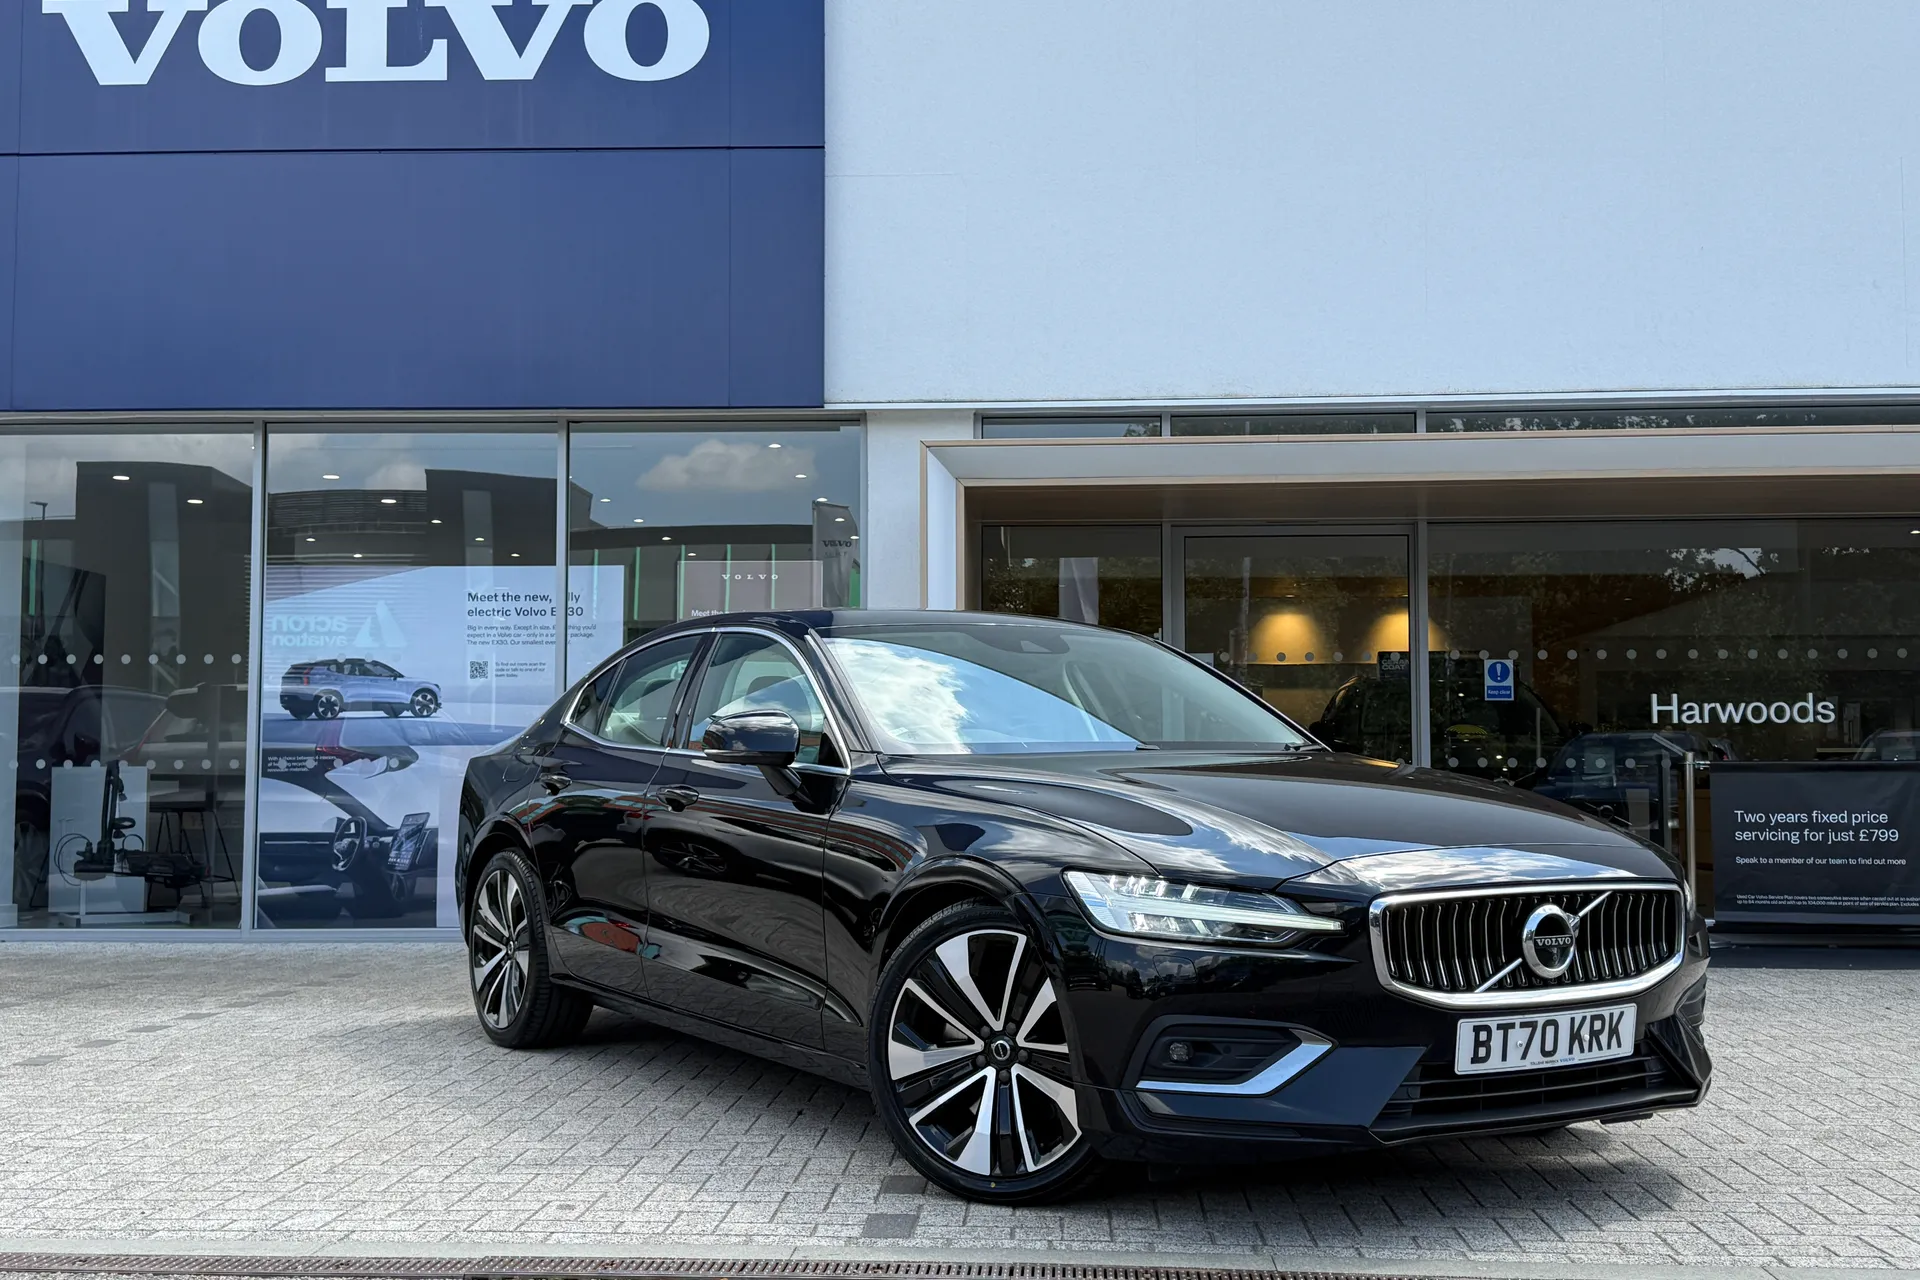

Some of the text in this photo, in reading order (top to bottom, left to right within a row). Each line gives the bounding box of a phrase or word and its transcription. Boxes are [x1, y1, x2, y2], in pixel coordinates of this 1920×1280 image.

[41, 0, 709, 87] VOLVO
[468, 592, 498, 602] Meet
[502, 592, 520, 602] the
[524, 594, 552, 604] new,
[468, 606, 584, 616] electric Volvo E30
[1651, 692, 1836, 724] Harwoods
[1734, 810, 1888, 826] Two years fixed price
[1734, 828, 1899, 844] servicing for just £799
[1736, 856, 1758, 864] Speak
[1536, 937, 1572, 946] VOLVO
[1470, 1011, 1624, 1064] BT70 KRK
